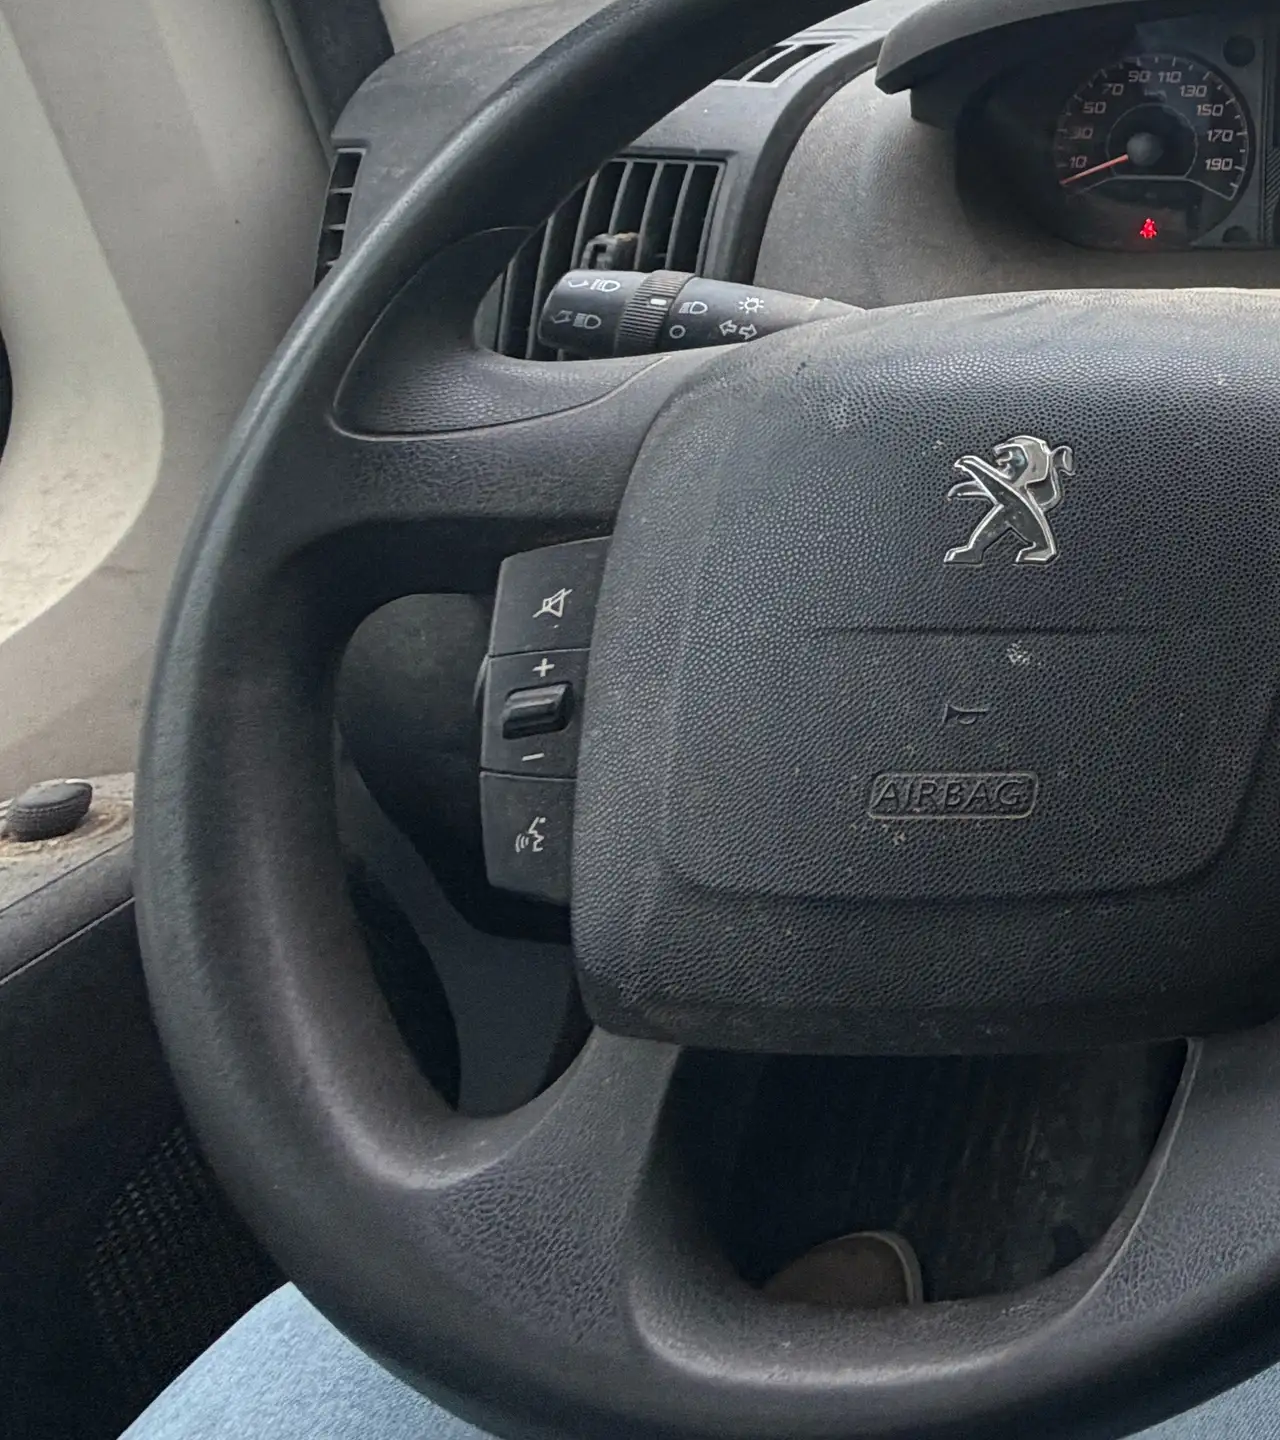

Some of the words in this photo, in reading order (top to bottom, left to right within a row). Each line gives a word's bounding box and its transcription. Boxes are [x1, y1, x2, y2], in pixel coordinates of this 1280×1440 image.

[1128, 70, 1150, 83] 90
[1158, 70, 1182, 83] 110
[1102, 83, 1124, 96] 70
[1180, 85, 1207, 98] 130
[1083, 101, 1107, 114] 50
[1196, 104, 1224, 117] 150
[1207, 129, 1233, 142] 170
[1069, 155, 1088, 169] 10
[1205, 158, 1233, 171] 190
[871, 778, 1025, 810] AIRBAG
